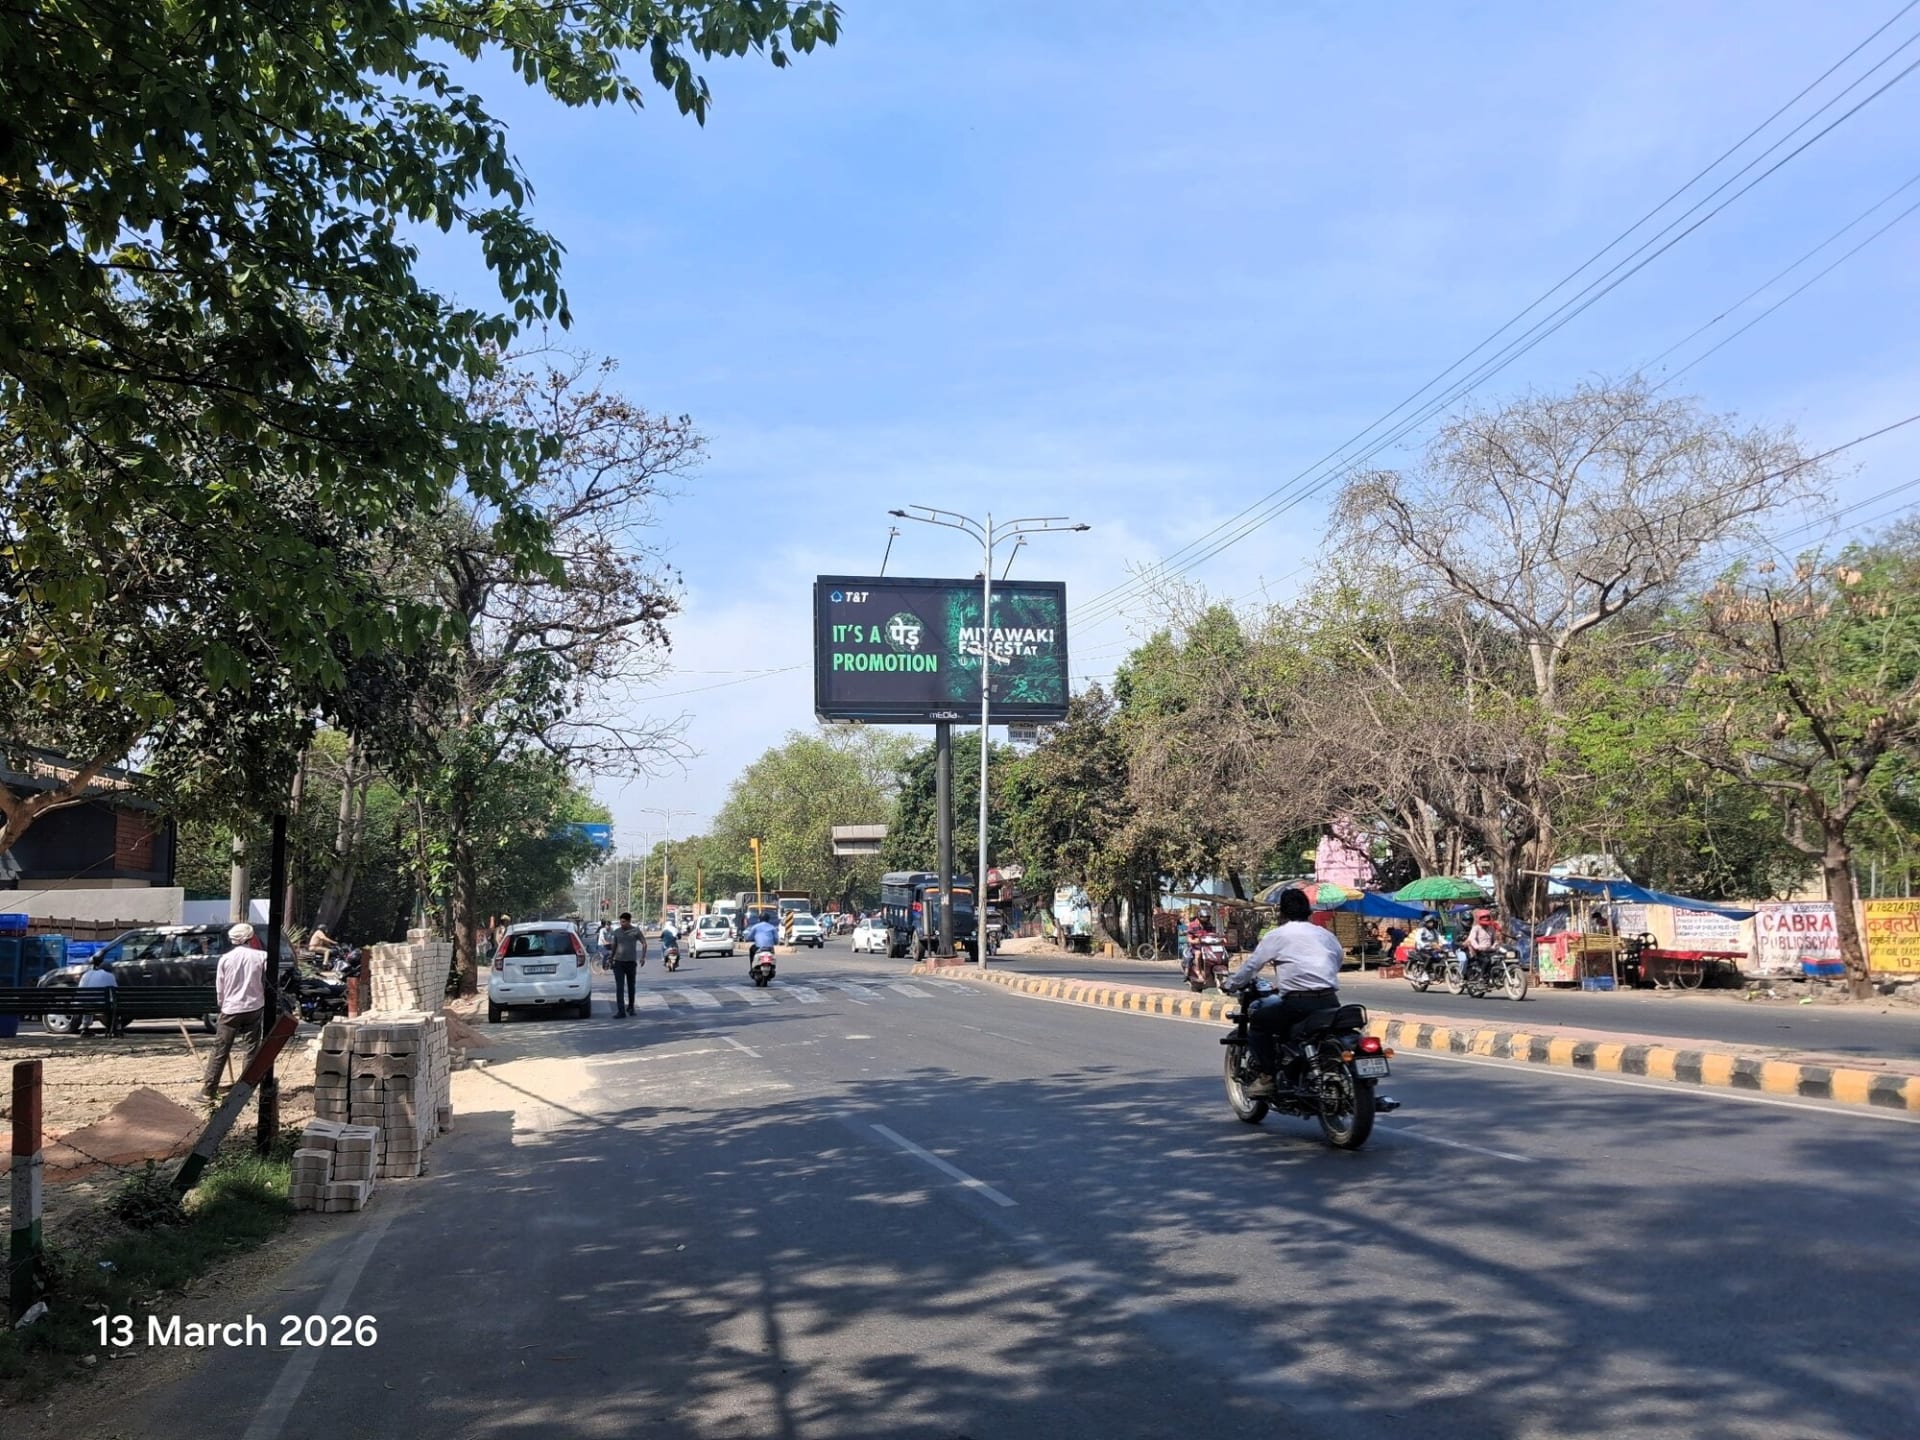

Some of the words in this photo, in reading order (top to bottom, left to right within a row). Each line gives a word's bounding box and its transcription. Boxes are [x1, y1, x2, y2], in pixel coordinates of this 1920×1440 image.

[845, 592, 869, 603] T&T
[832, 625, 864, 643] IT'S
[869, 626, 882, 643] A
[889, 616, 921, 651] पेड़
[1023, 646, 1038, 655] AT
[833, 653, 938, 673] PROMOTION
[1763, 914, 1833, 932] CABRA
[1805, 934, 1841, 950] SCHOO
